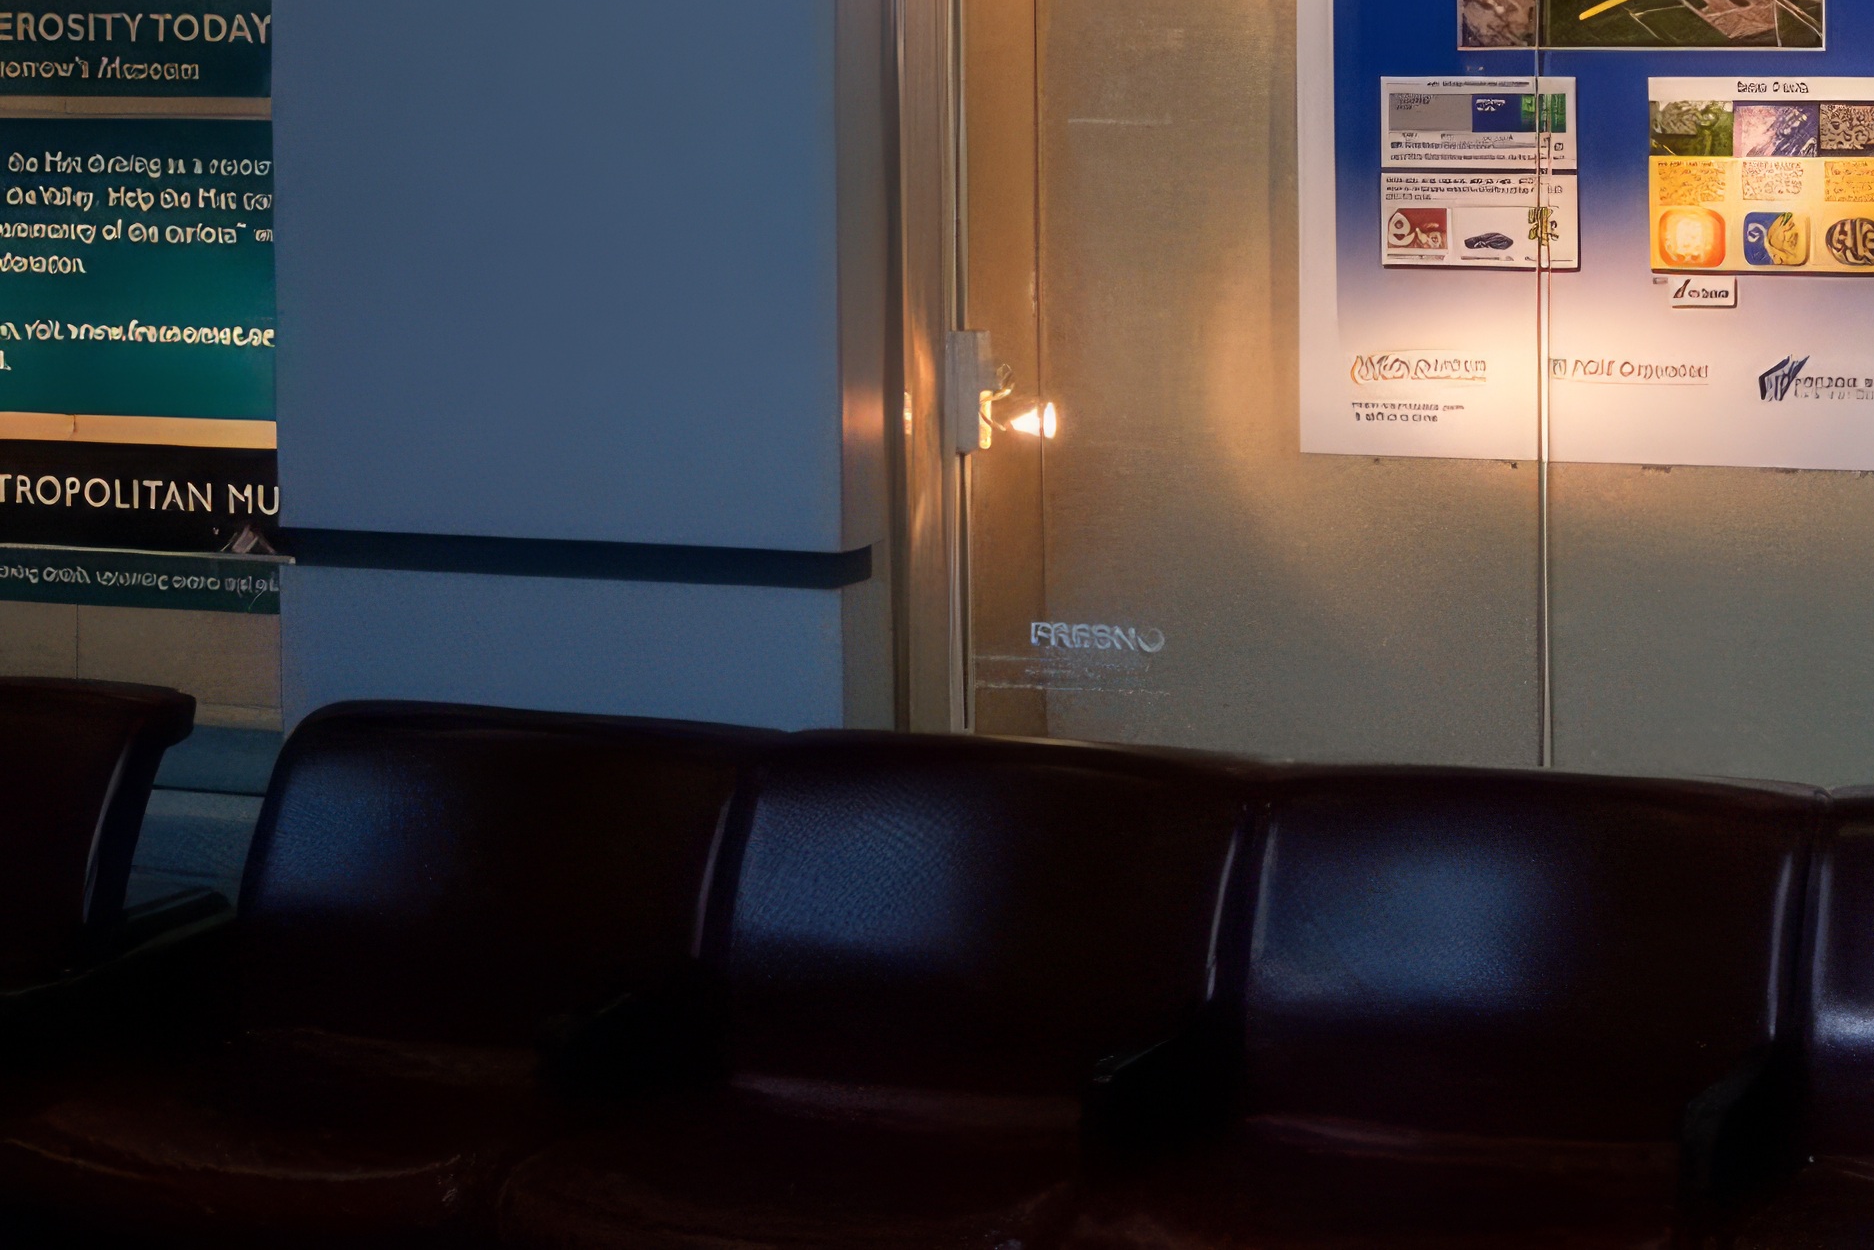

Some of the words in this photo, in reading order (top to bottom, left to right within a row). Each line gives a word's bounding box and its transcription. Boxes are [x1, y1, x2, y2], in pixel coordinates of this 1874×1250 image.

[150, 12, 271, 44] TODAY
[228, 484, 279, 516] MU
[1031, 621, 1165, 653] FRESNO
